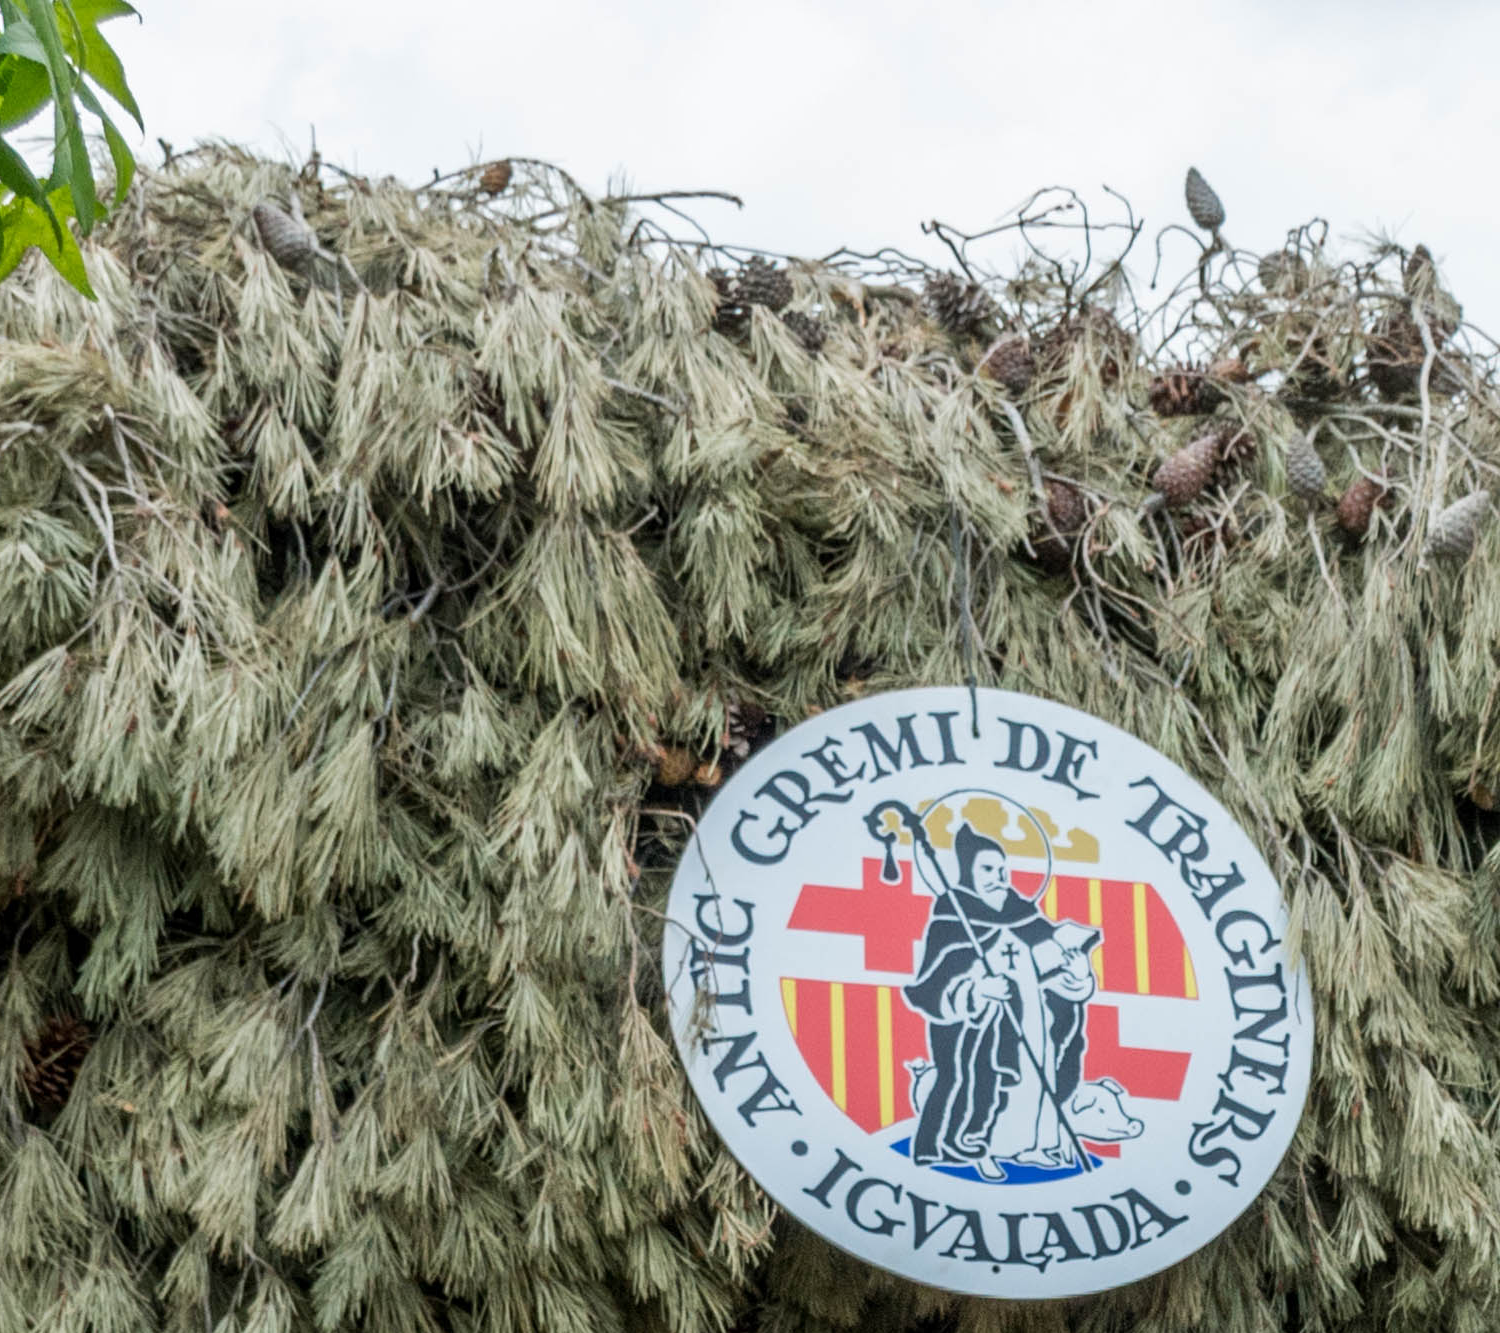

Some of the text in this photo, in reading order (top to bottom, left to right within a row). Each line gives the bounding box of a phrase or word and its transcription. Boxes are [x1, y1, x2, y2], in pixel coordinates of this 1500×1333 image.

[691, 710, 1292, 1188] ANTIC GREMI DE TRAGINERS
